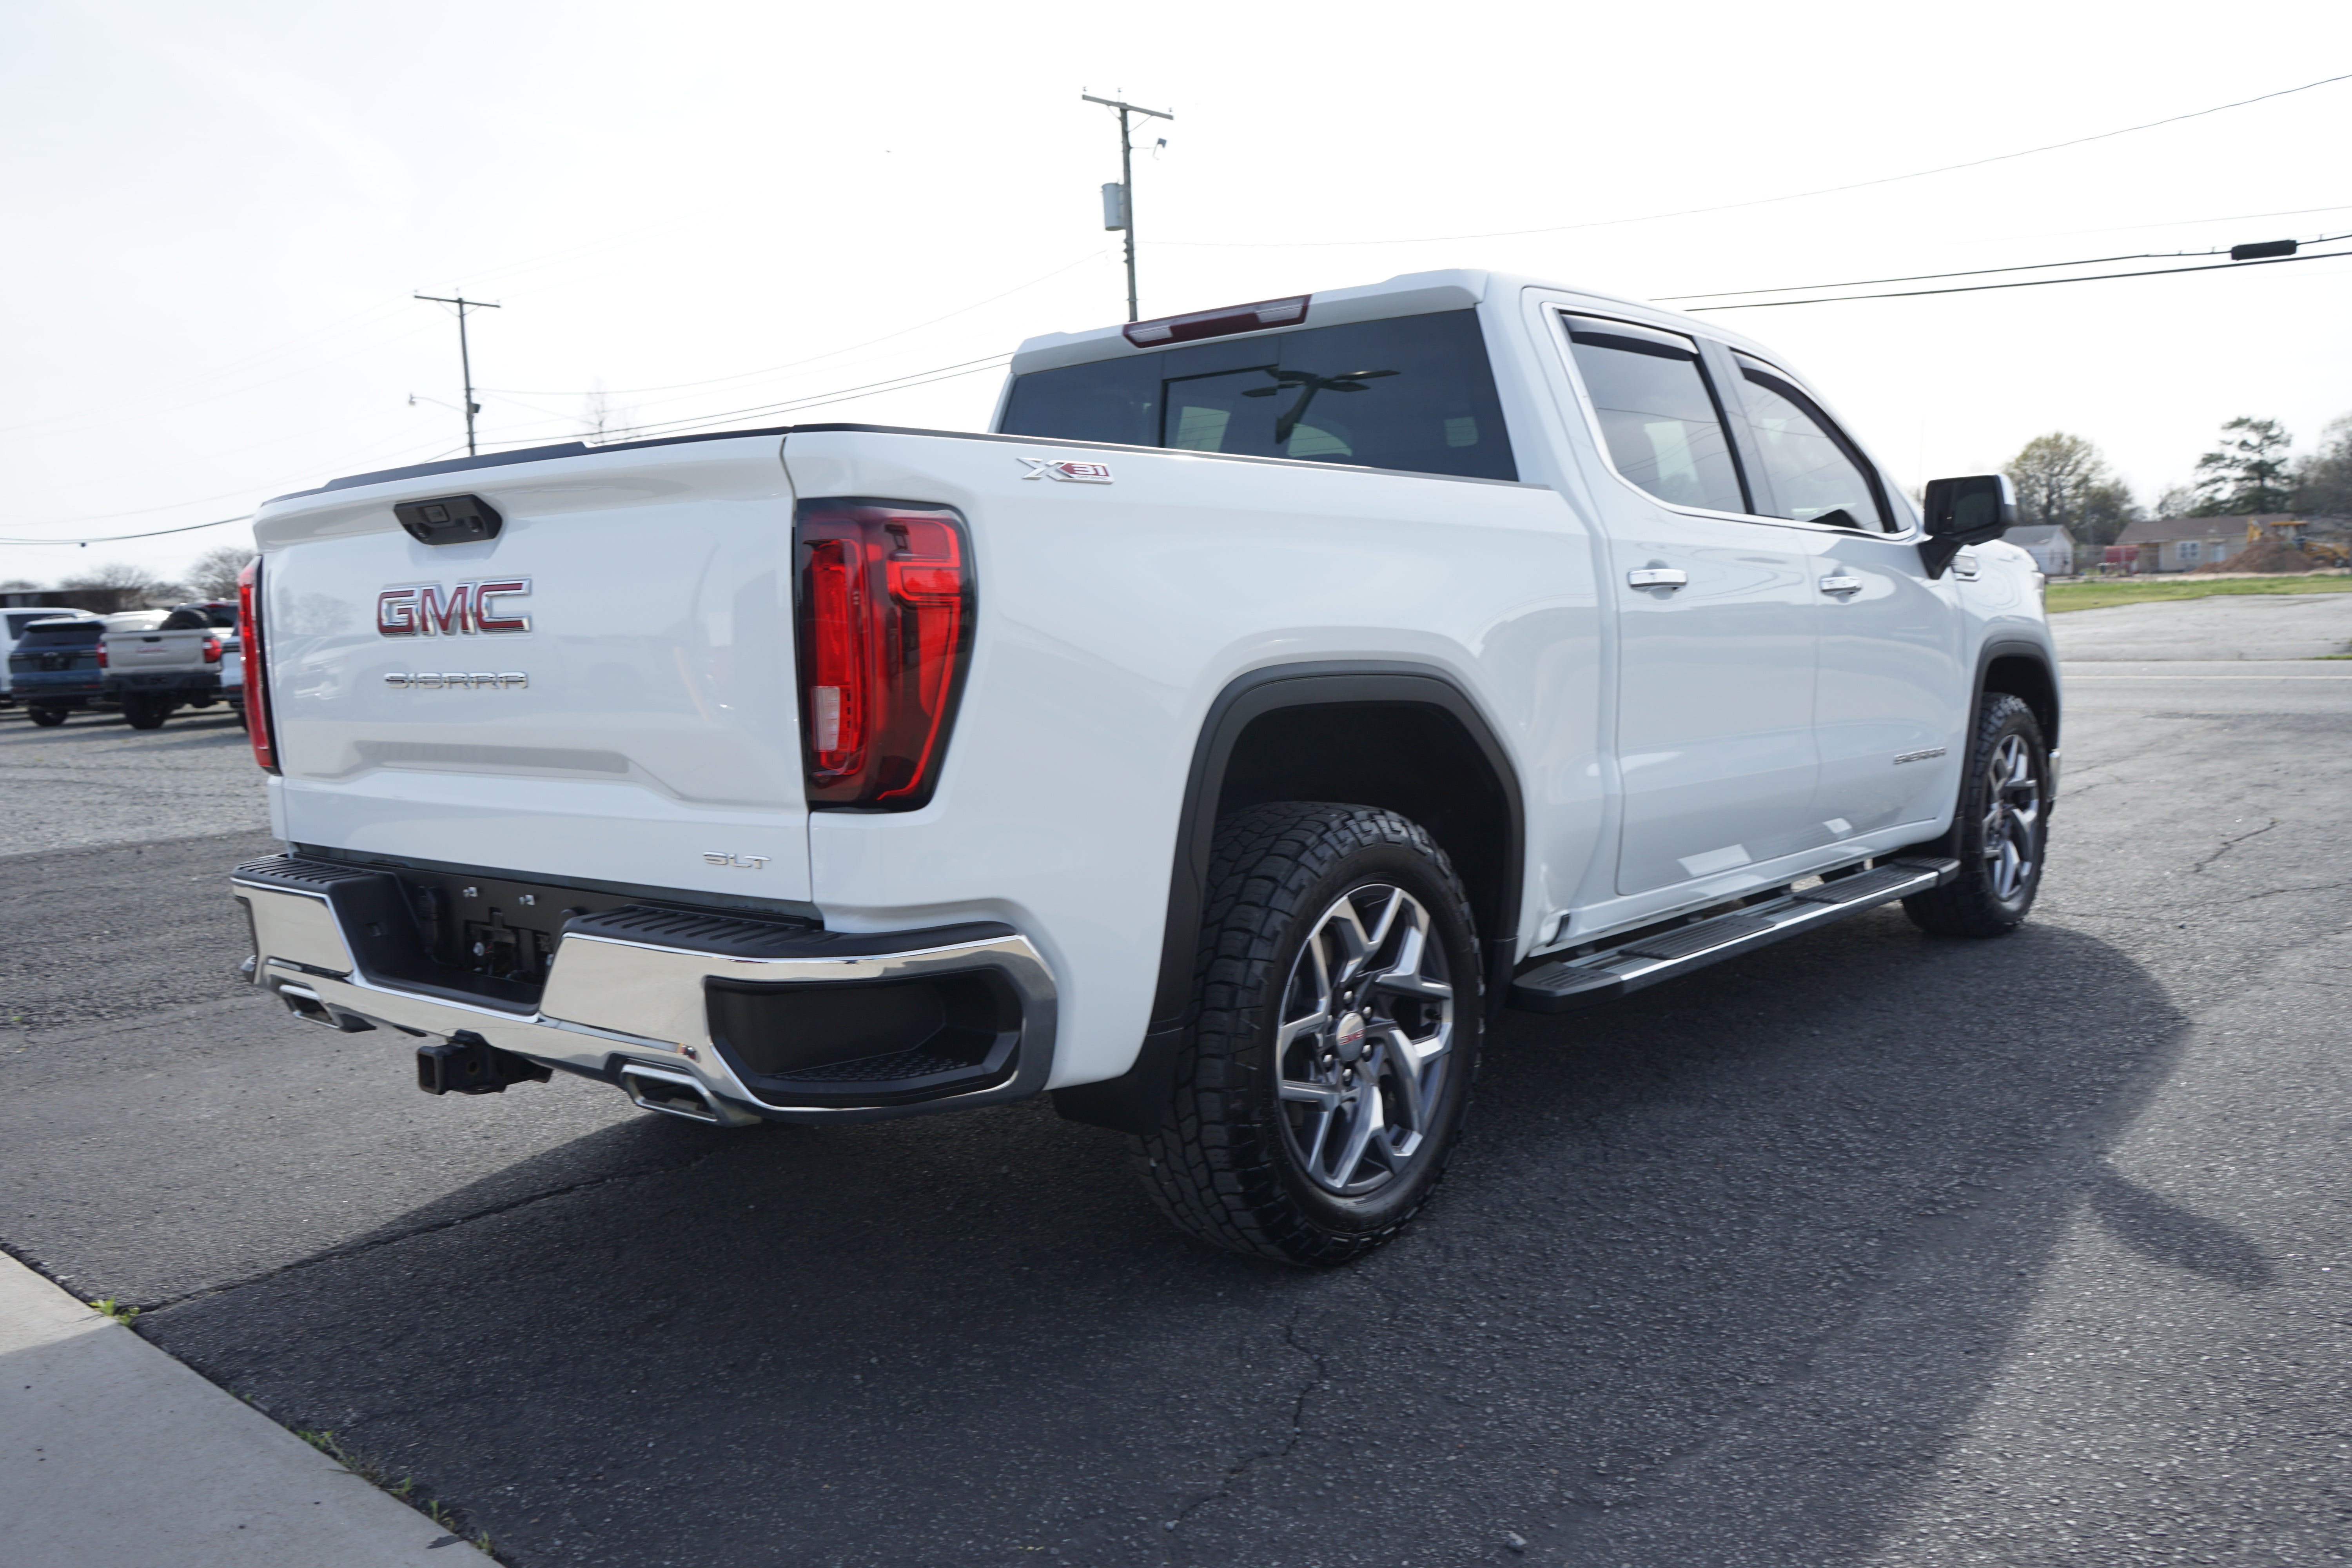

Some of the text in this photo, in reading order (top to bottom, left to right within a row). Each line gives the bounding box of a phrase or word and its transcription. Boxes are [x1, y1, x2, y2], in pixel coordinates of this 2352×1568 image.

[1016, 457, 1114, 485] X31
[377, 578, 532, 636] GMC
[384, 671, 528, 689] SIERRA
[702, 851, 771, 869] SLT
